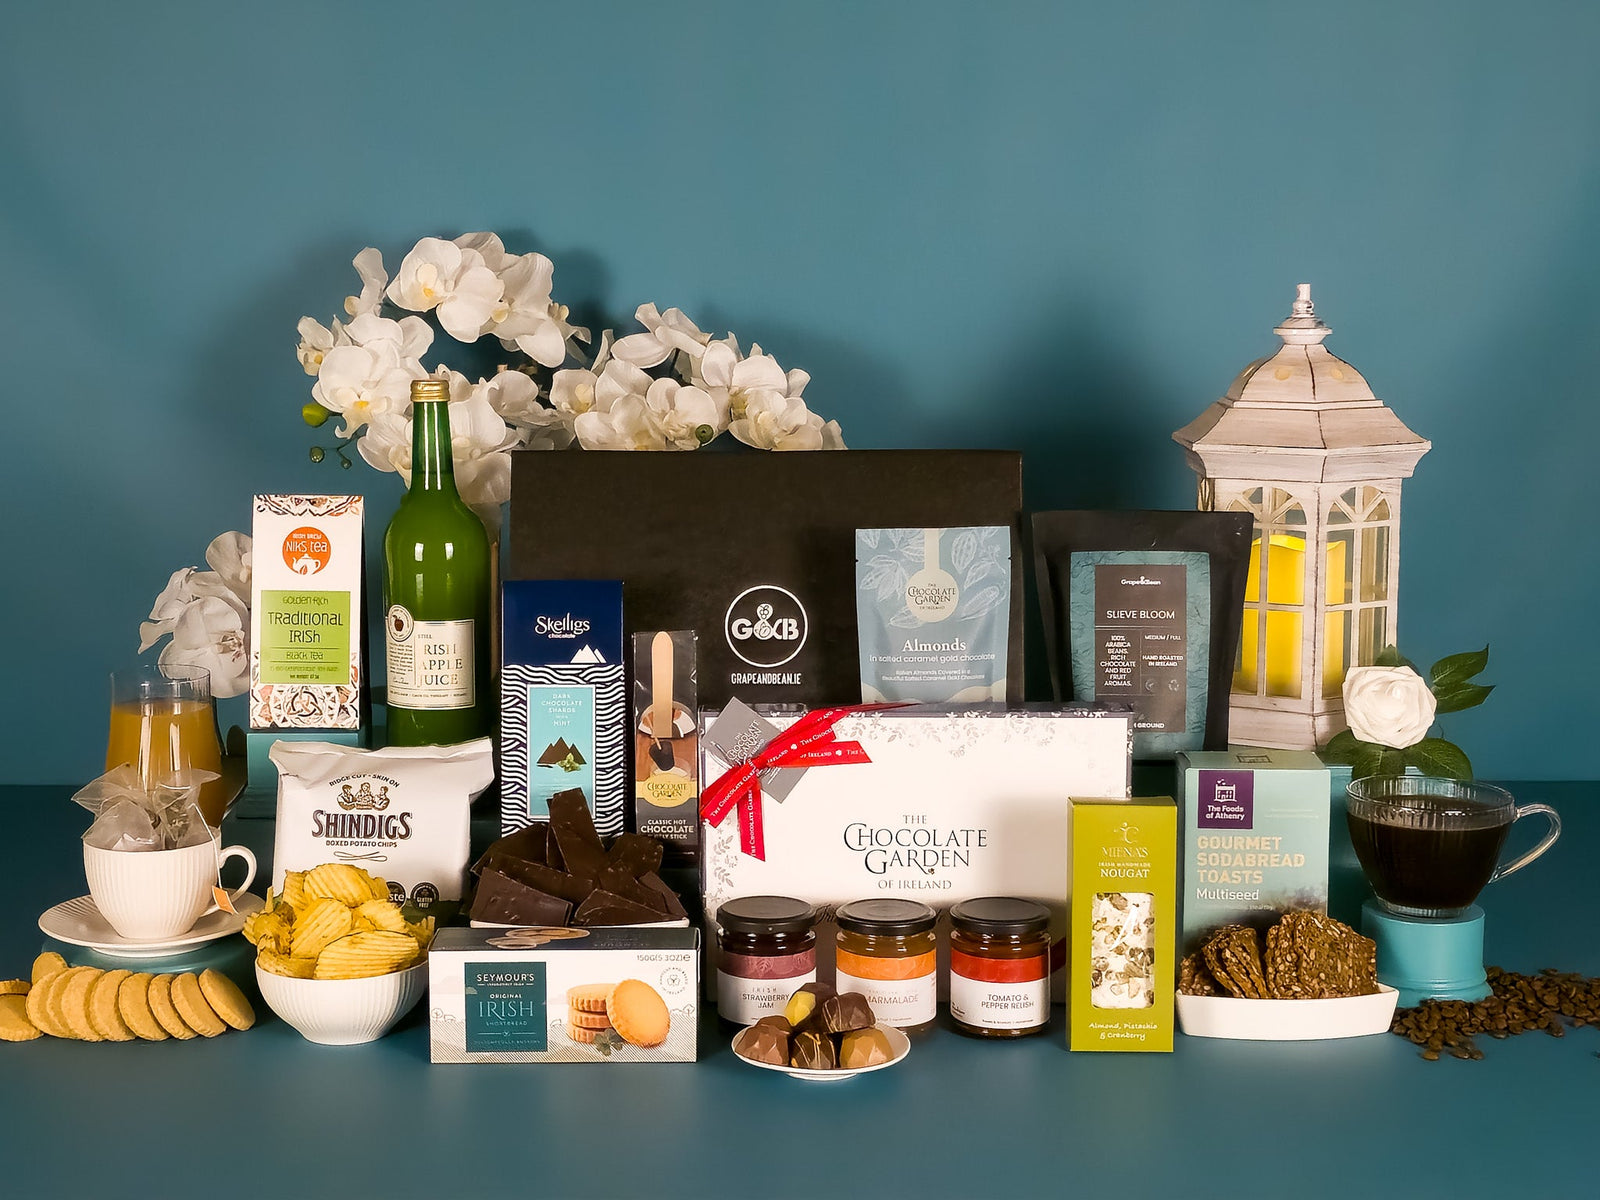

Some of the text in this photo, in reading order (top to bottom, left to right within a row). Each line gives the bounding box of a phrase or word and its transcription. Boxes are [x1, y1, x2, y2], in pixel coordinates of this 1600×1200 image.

[908, 586, 956, 598] CHOCOLATE
[915, 595, 951, 605] GARDEN
[1106, 610, 1175, 619] SLIEVE BLOOM
[534, 612, 591, 635] Skelligs
[731, 603, 800, 641] G&B
[419, 643, 457, 656] RISH
[902, 638, 967, 652] Almonds
[418, 658, 464, 671] APPLE
[878, 654, 903, 663] salted
[903, 654, 939, 663] caramel
[939, 655, 959, 664] gold
[960, 653, 996, 662] chocolate
[417, 673, 459, 688] JUICE
[731, 672, 802, 685] GRAPEANDBEAN.IE
[800, 727, 833, 746] THE CHOCO
[329, 775, 351, 787] RIDGE
[372, 774, 389, 783] SKIN
[388, 779, 400, 788] ON
[719, 780, 744, 808] CHOCOLATE
[902, 814, 928, 824] THE
[1214, 812, 1245, 821] Athenry
[311, 810, 413, 840] SHINDIGS
[640, 825, 695, 833] CHOCOLATE
[843, 822, 988, 851] CHOCOLATE
[1197, 835, 1283, 851] GOURMET
[864, 849, 970, 875] GARDEN
[1196, 852, 1305, 868] SODABREAD
[1100, 868, 1150, 878] NOUGAT
[1196, 869, 1263, 884] TOASTS
[877, 879, 952, 890] OF IRELAND
[388, 893, 405, 902] ste
[1196, 887, 1260, 901] Multiseed
[476, 973, 535, 982] SEYMOUR'S
[742, 993, 790, 1002] STRAWBERRY
[987, 993, 1029, 1002] TOMATO &
[479, 1000, 534, 1021] IRISH
[981, 1000, 1035, 1010] PEPPER RELISH
[1123, 1022, 1158, 1030] Pistachio
[1107, 1032, 1146, 1042] Cranberry
